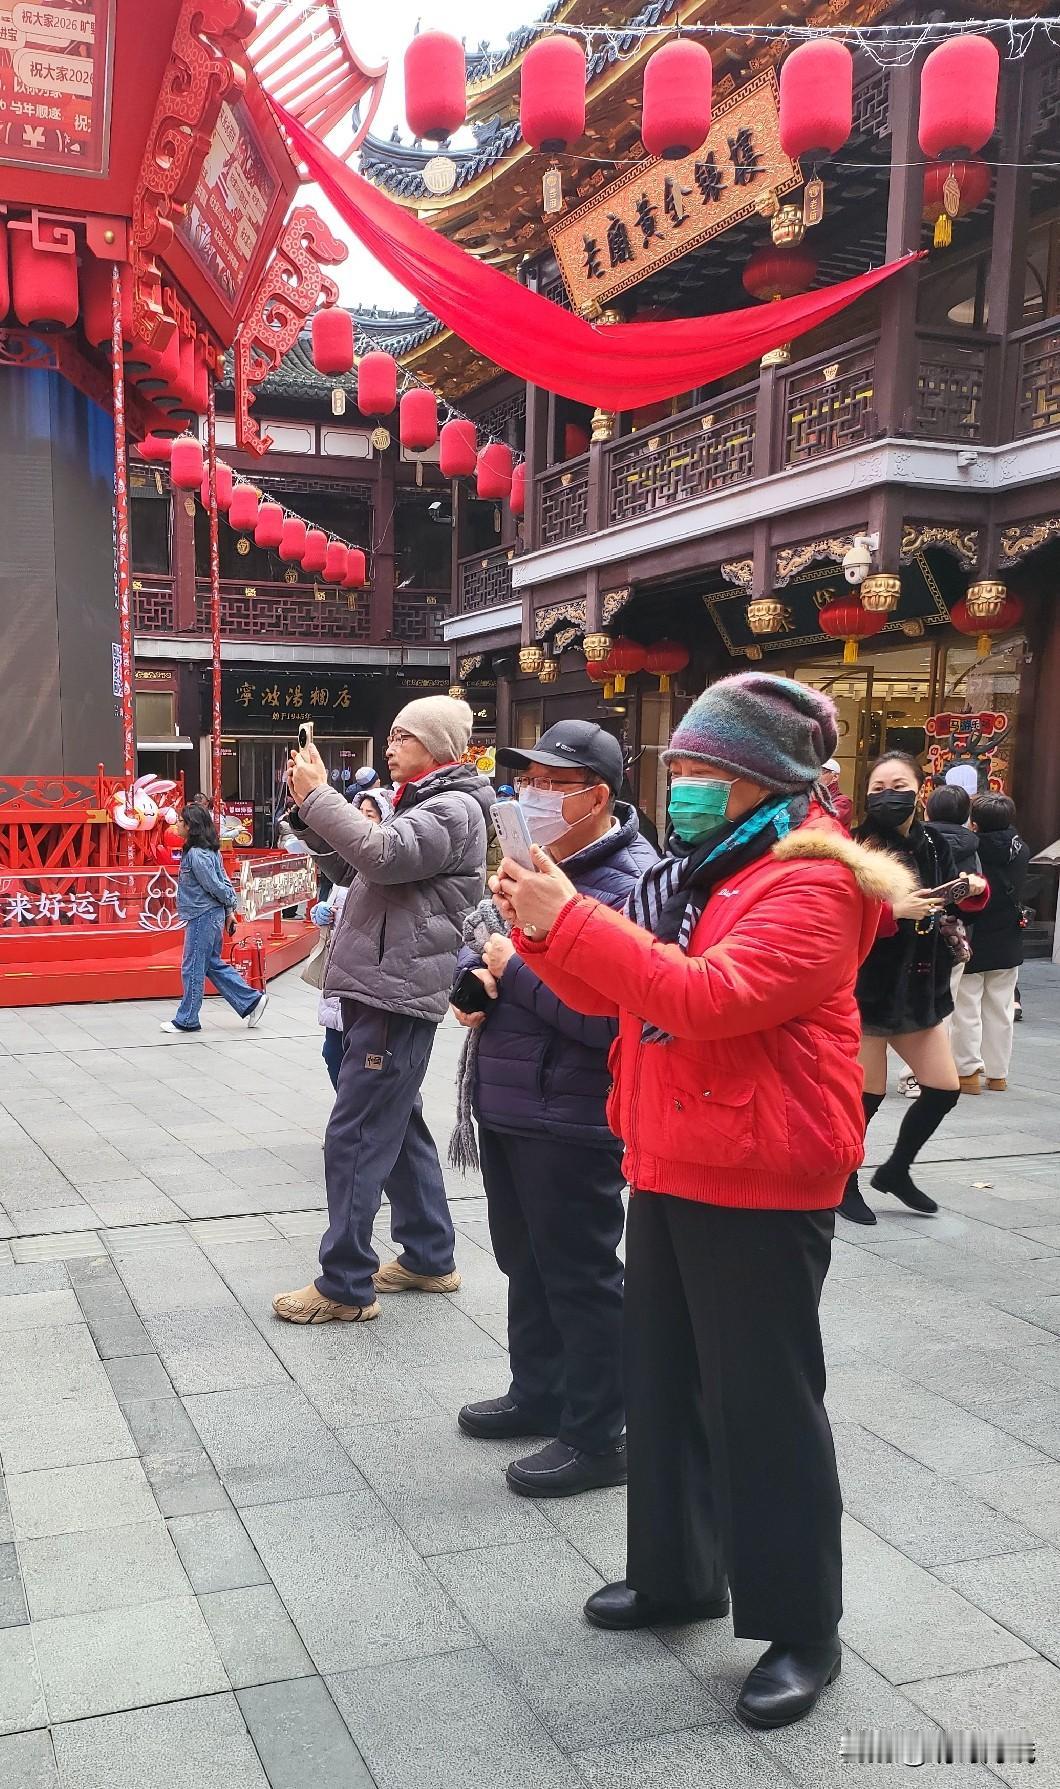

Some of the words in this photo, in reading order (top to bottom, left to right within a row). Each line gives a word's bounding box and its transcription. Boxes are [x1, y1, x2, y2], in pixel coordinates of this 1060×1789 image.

[21, 8, 77, 31] 祝大家2026
[3, 888, 127, 923] 来好运气
